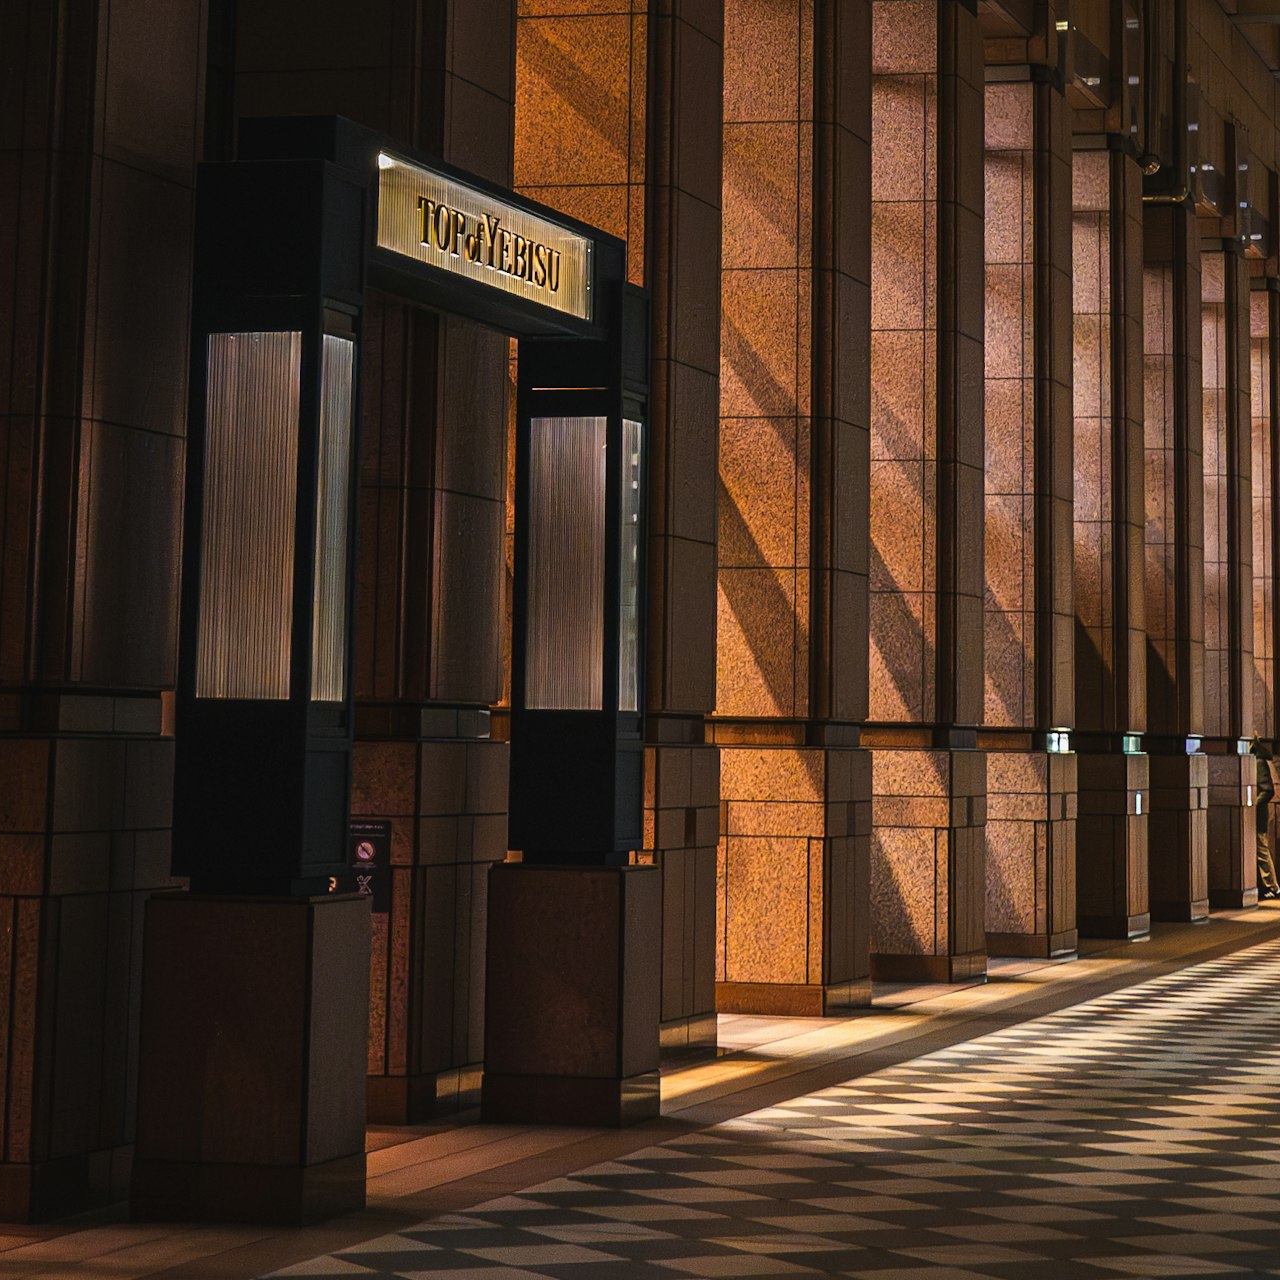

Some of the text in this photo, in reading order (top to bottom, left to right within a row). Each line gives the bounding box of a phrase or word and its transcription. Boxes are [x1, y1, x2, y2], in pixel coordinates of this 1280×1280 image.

[418, 196, 561, 293] TOP of YEBISU
